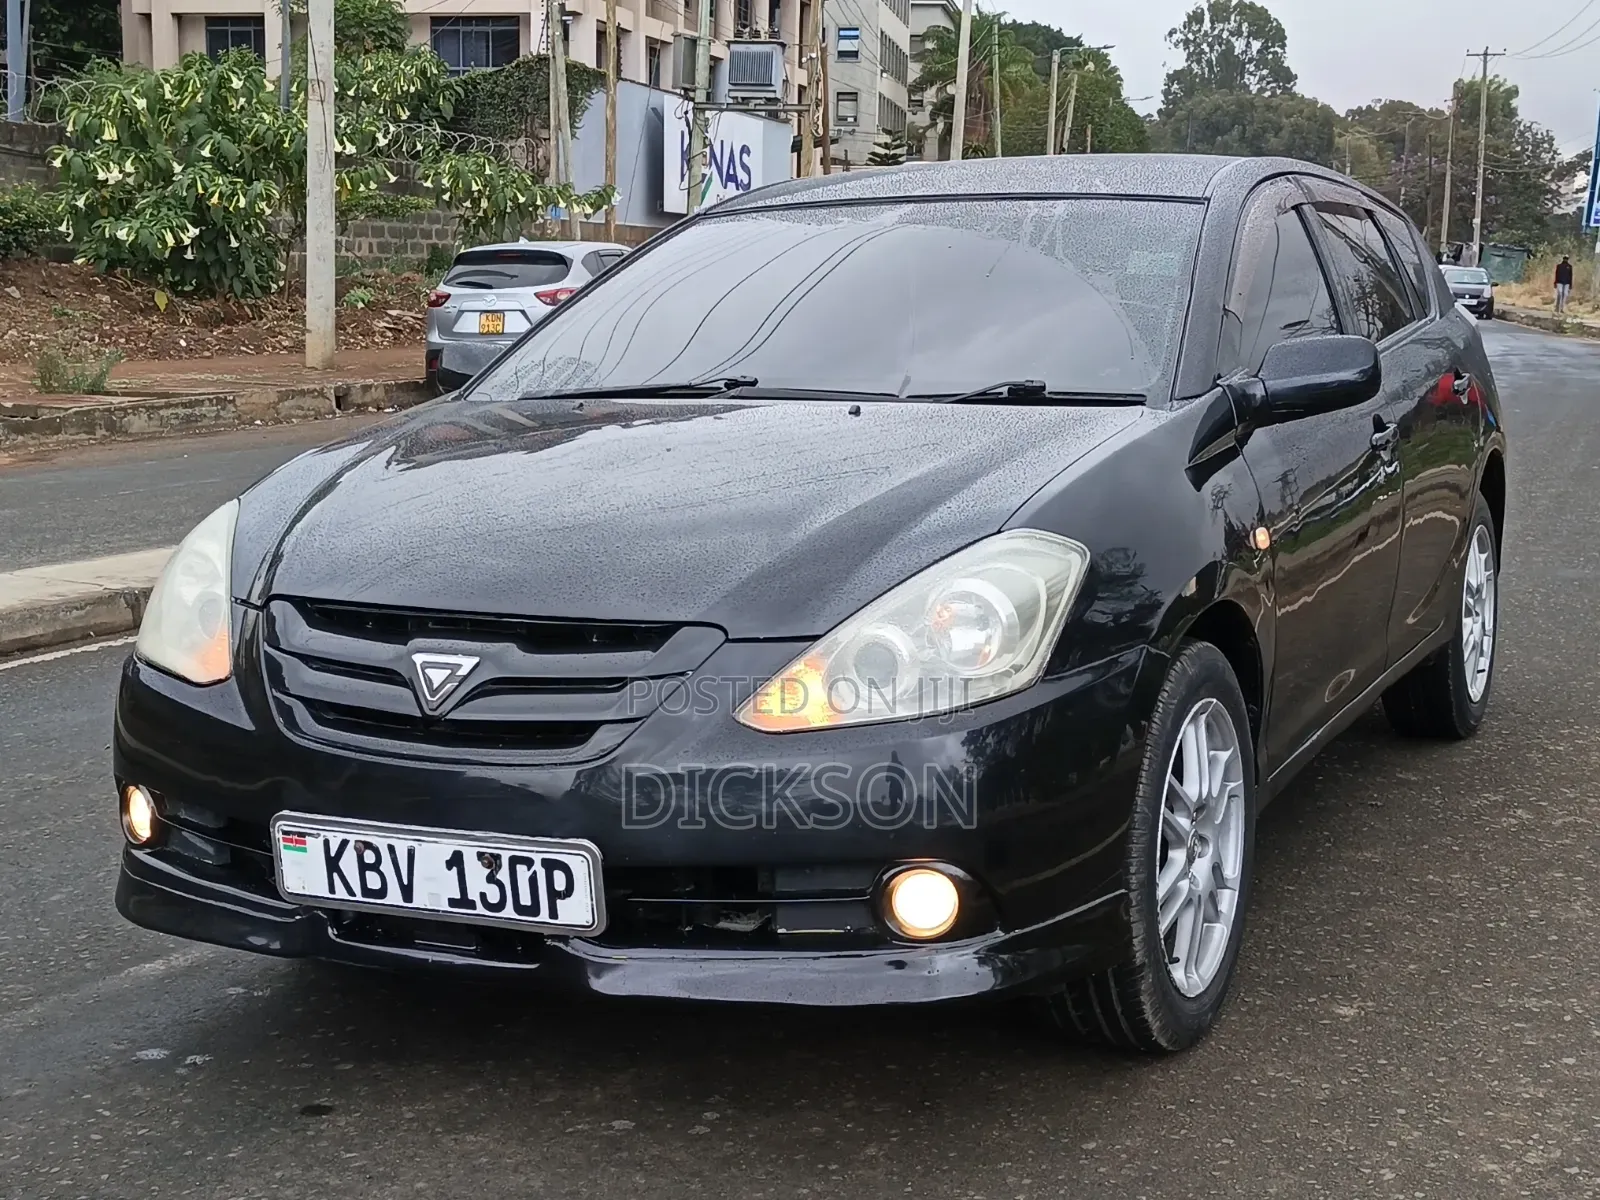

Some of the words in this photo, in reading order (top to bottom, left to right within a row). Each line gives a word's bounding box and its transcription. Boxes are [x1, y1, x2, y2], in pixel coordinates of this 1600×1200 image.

[681, 130, 752, 192] KNAS
[322, 837, 416, 904] KBV
[445, 849, 575, 920] 130P
